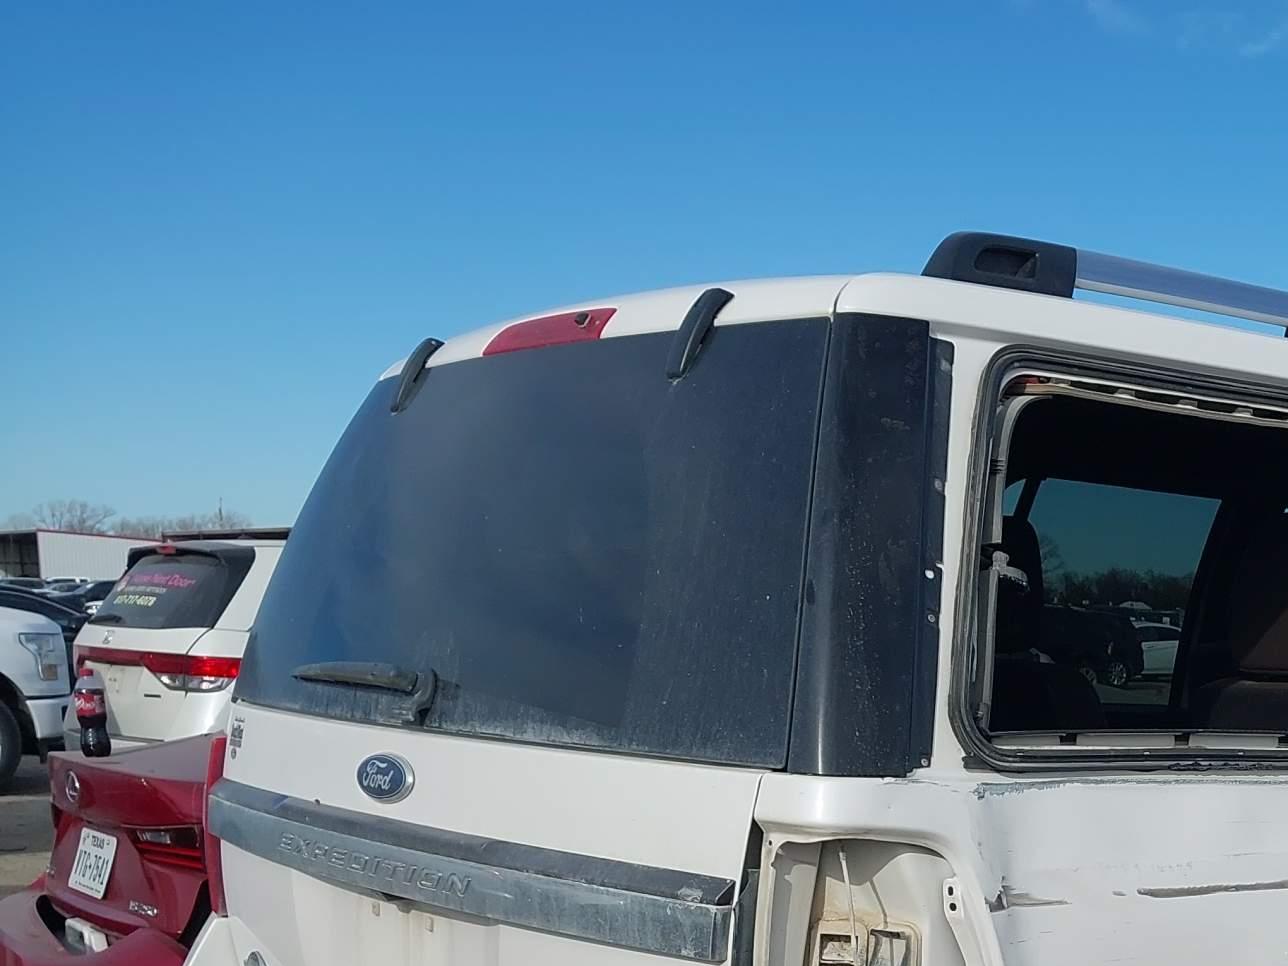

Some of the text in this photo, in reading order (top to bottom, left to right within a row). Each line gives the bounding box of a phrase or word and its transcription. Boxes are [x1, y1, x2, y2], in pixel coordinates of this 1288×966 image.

[362, 759, 395, 791] Ford
[91, 834, 105, 850] TEXAS
[278, 831, 473, 898] EXPEDITION
